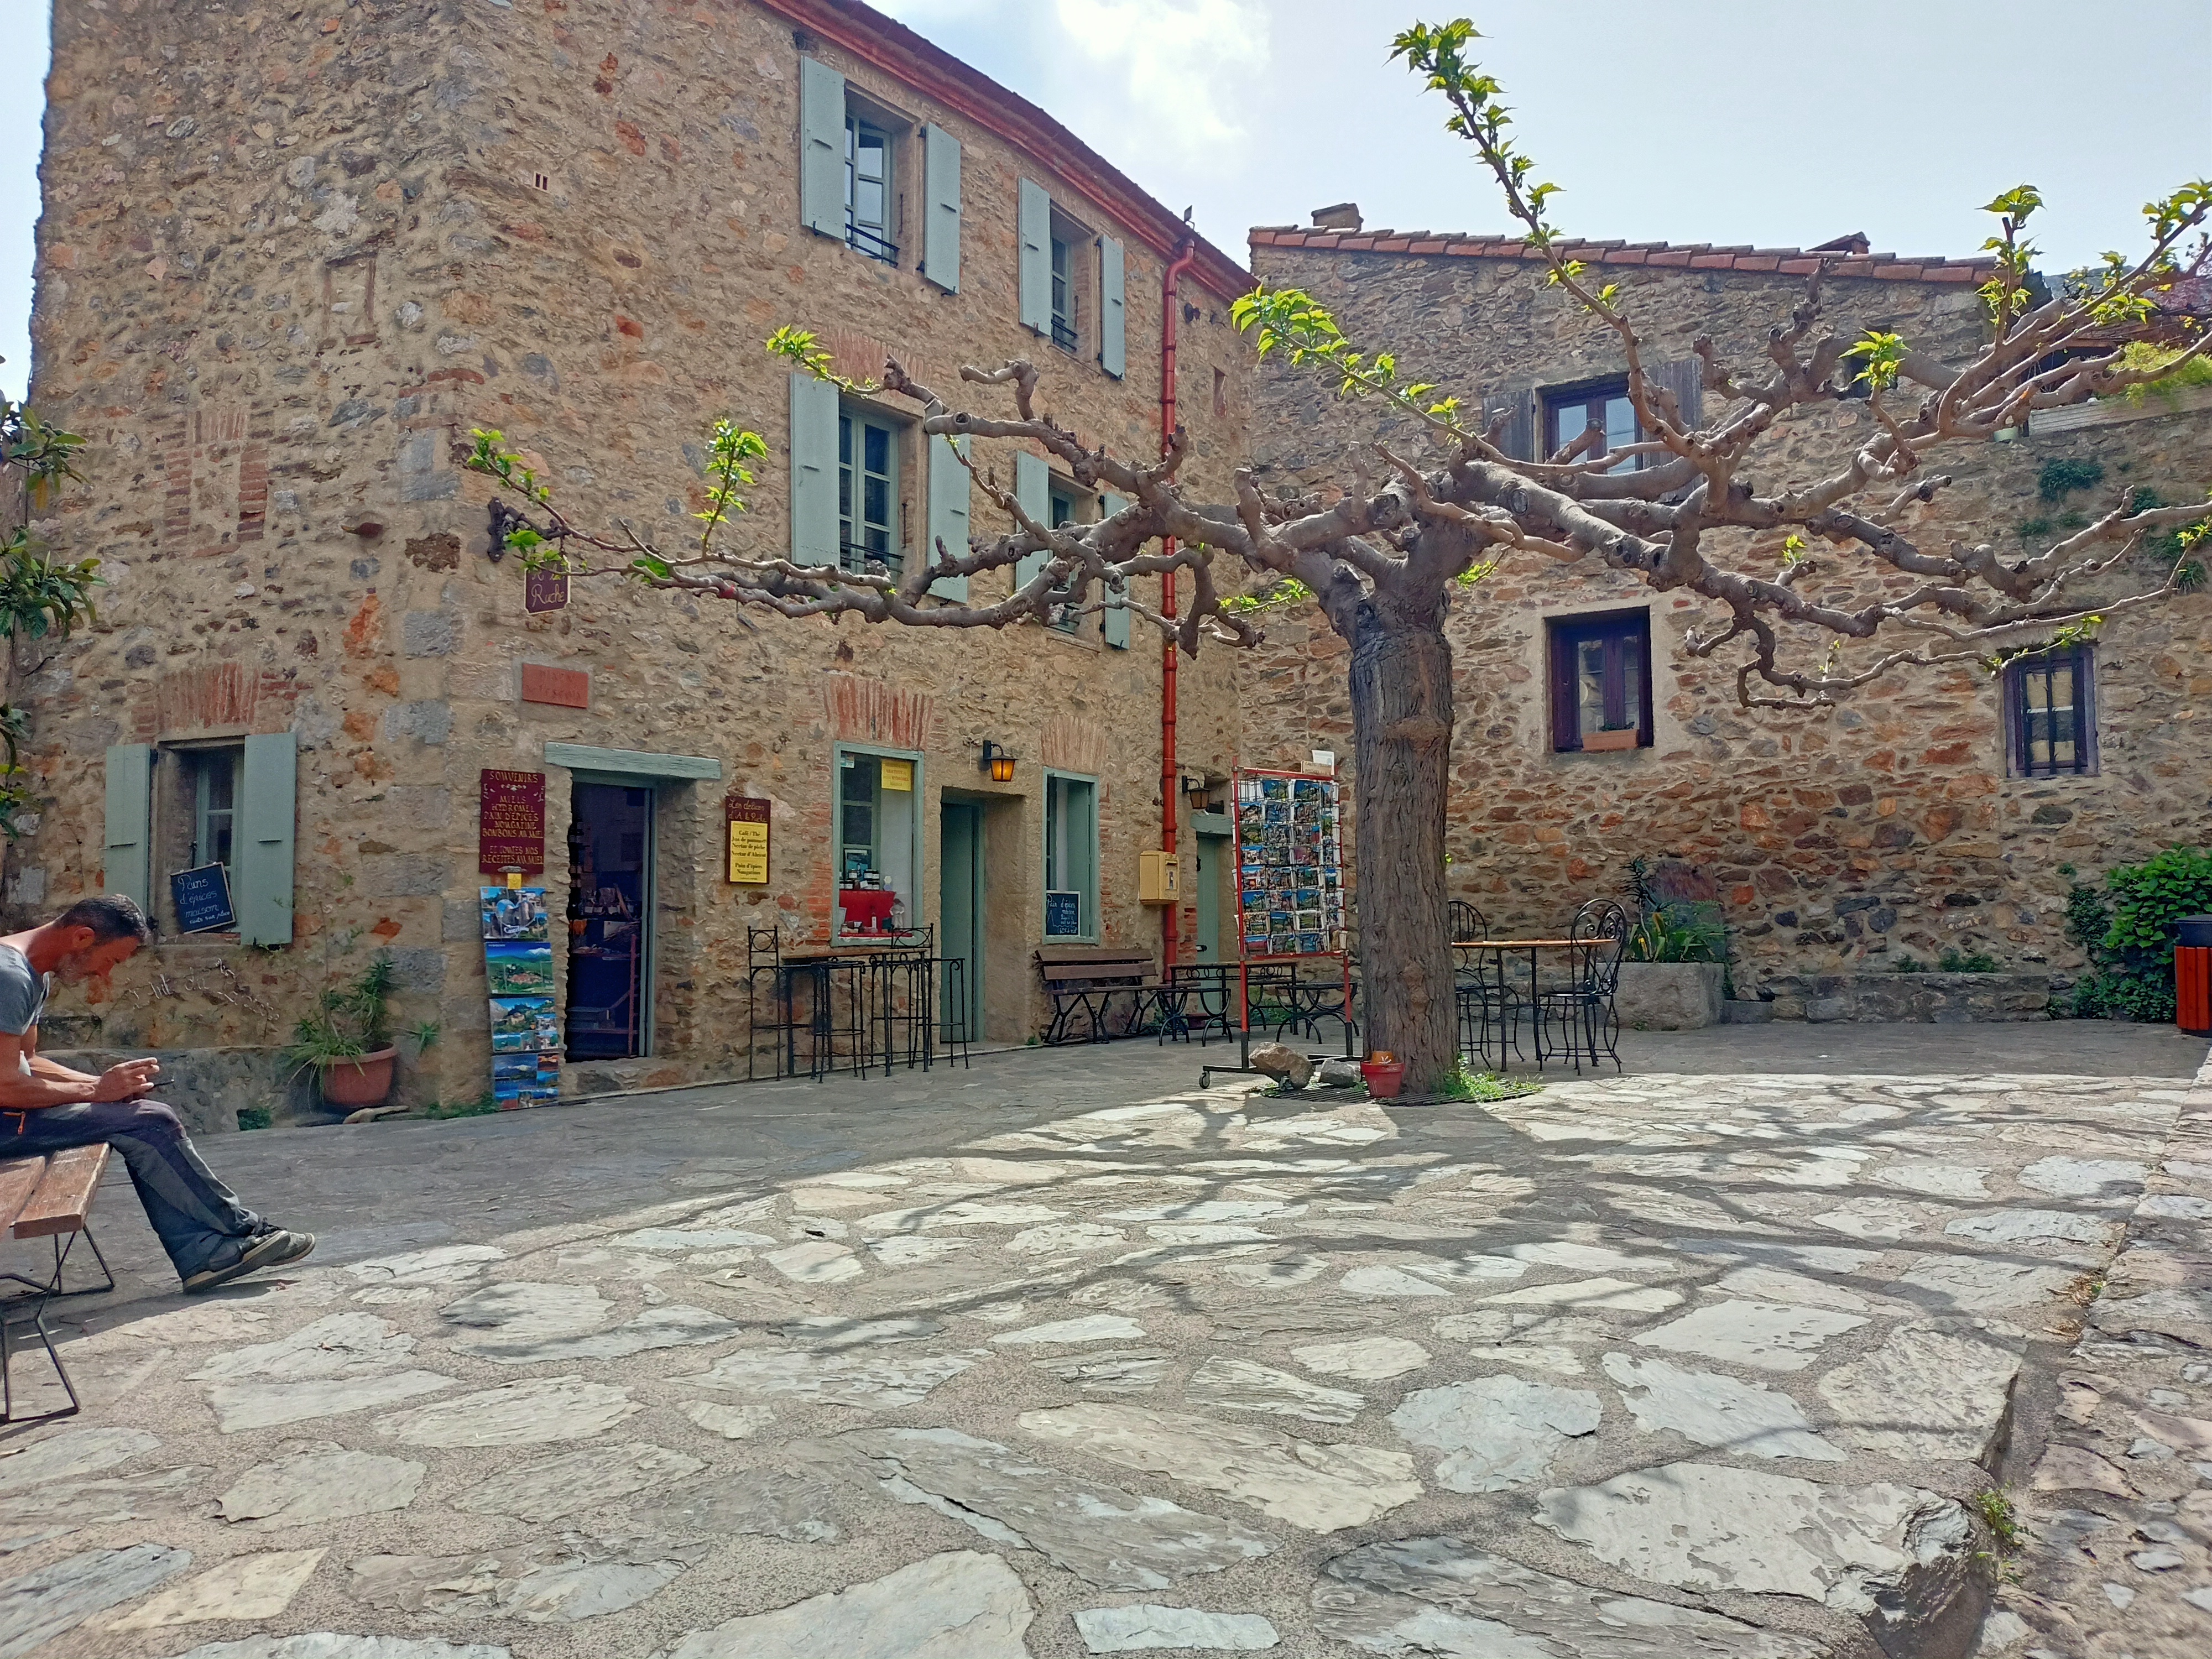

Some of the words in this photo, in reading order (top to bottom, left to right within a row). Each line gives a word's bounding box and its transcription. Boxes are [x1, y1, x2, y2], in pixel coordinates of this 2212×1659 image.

[531, 583, 565, 607] Ruche
[489, 771, 539, 783] SOUVENIRS
[499, 795, 526, 804] MIELS
[728, 798, 742, 809] Les
[484, 811, 502, 820] PAIN
[482, 828, 517, 837] BONBONS
[525, 847, 539, 855] NOS
[482, 854, 515, 864] RECETTES
[178, 874, 208, 891] Pains
[180, 890, 217, 907] d'épices
[185, 904, 220, 918] maison
